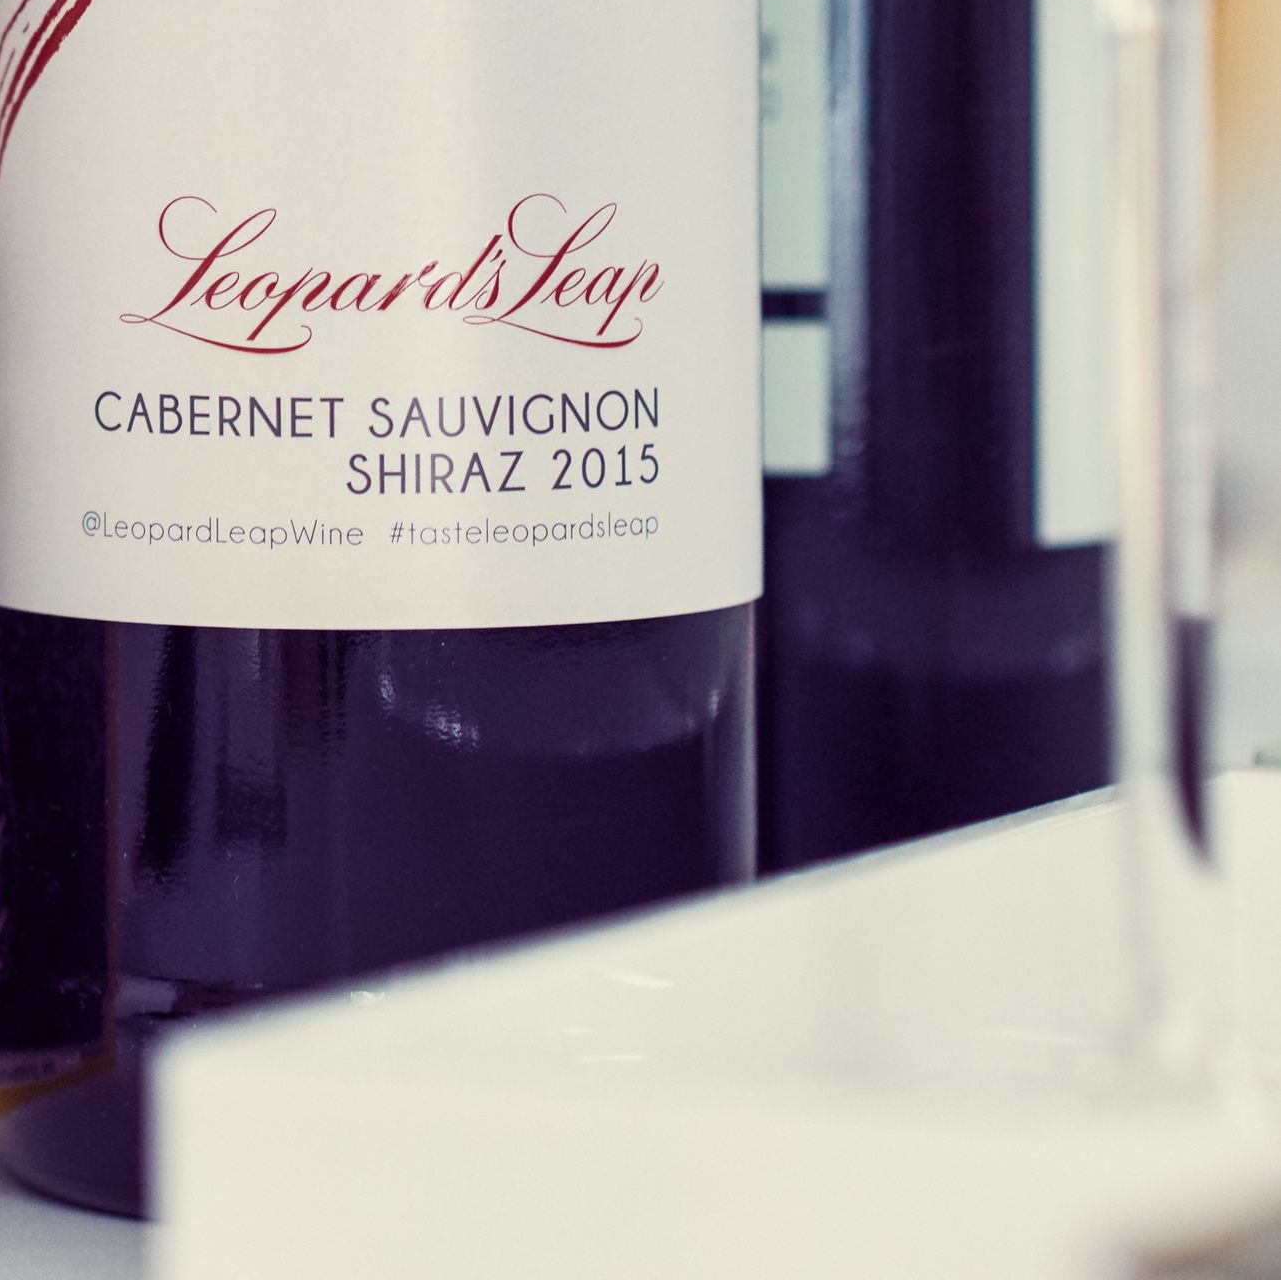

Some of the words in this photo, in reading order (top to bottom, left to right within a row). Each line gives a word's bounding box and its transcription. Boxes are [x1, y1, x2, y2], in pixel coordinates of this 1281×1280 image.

[120, 196, 507, 354] Leopard's
[463, 193, 665, 349] Leap
[95, 390, 345, 439] CABERNET
[369, 387, 661, 439] SAUVIGNON
[347, 451, 526, 496] SHIRAZ
[551, 443, 660, 492] 2015
[81, 509, 365, 551] @LeopardLeapWine
[389, 511, 660, 549] #tasteleopardsleap
